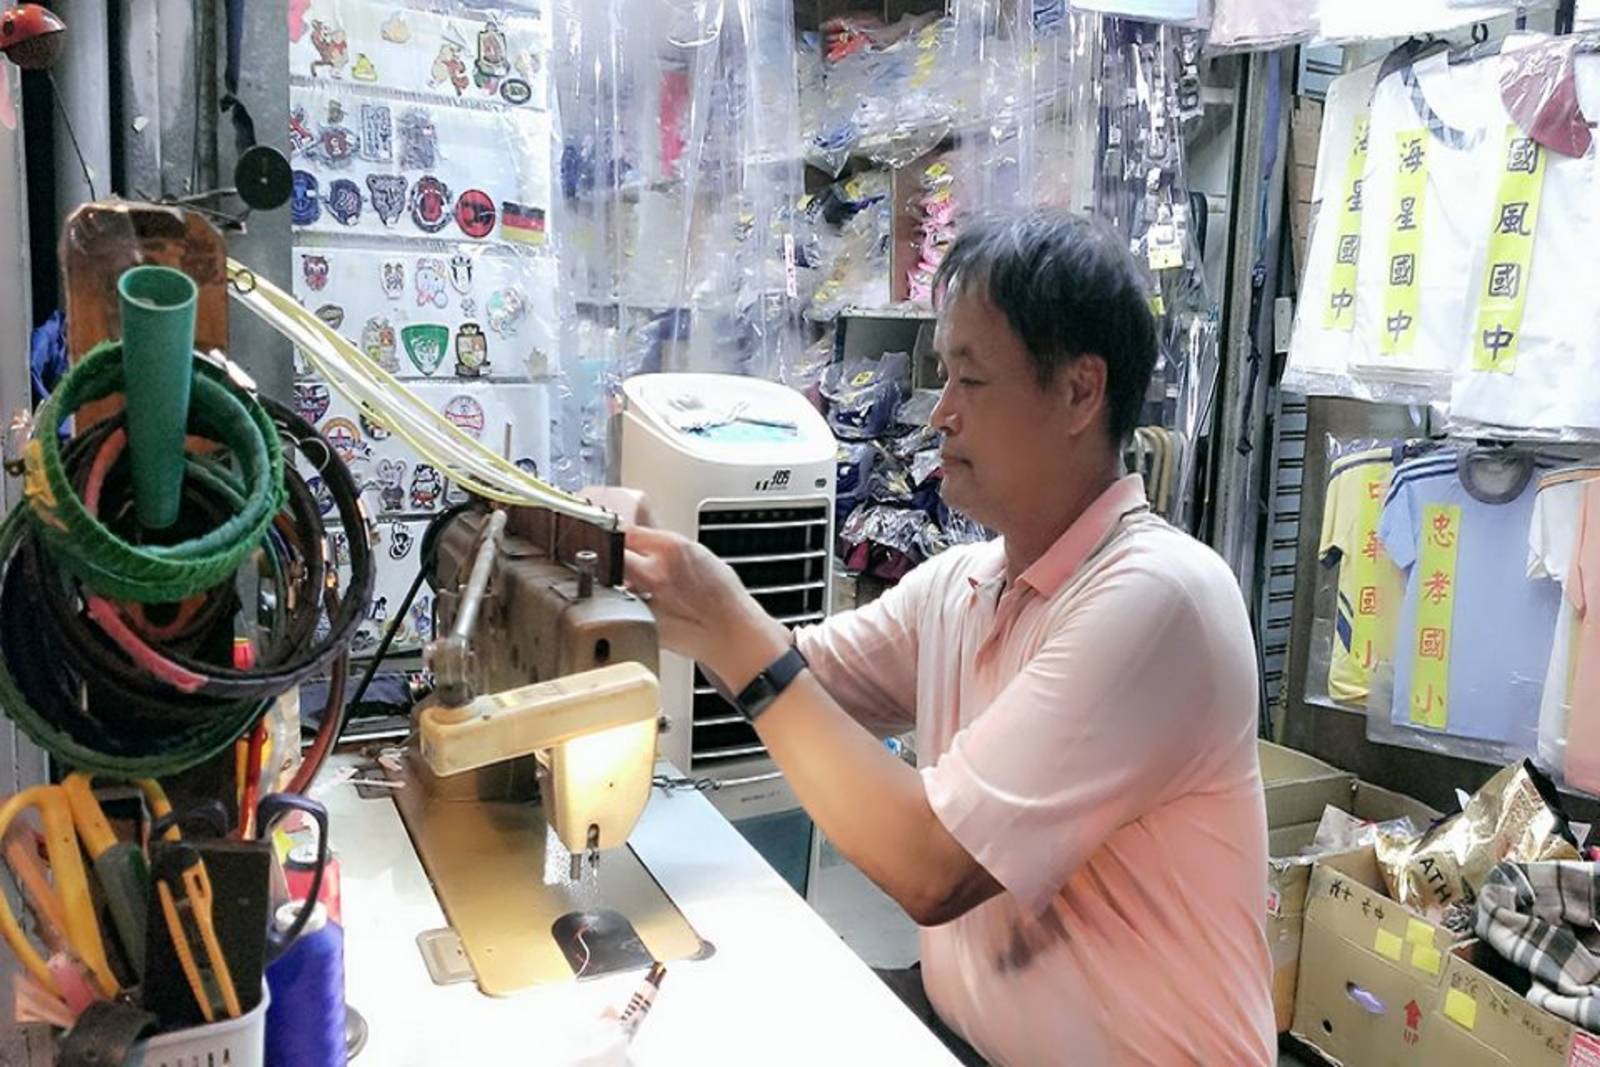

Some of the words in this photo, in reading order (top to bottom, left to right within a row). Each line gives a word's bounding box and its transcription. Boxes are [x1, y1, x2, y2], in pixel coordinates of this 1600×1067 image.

[1387, 138, 1425, 342] 海星國中
[1483, 137, 1539, 361] 國風國中
[1415, 514, 1456, 714] 忠孝國小
